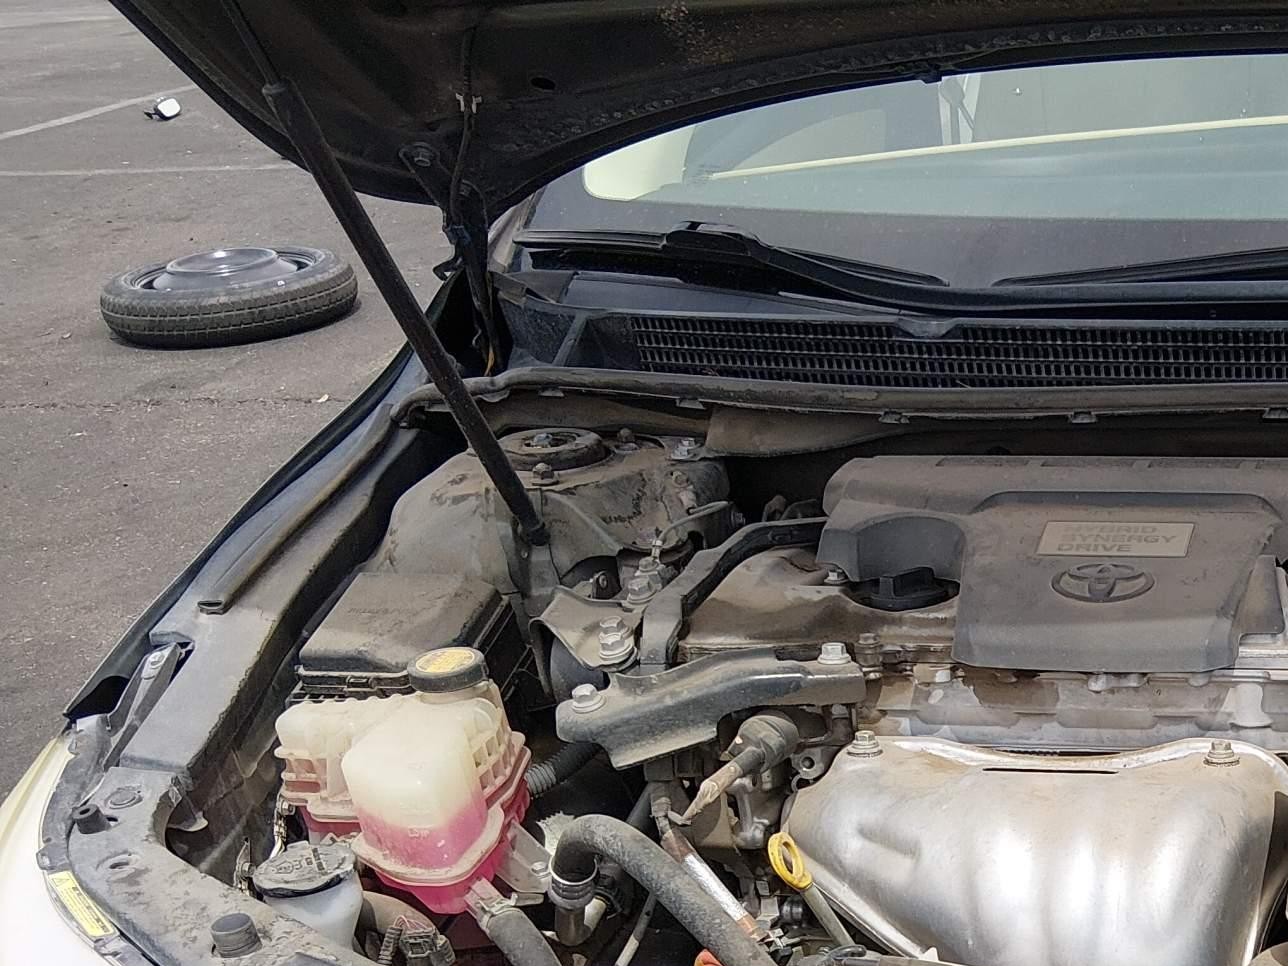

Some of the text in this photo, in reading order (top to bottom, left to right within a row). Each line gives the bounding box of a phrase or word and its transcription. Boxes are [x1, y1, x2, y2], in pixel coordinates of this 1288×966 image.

[1062, 525, 1158, 534] HYBRID
[1061, 534, 1178, 544] SYNERGY
[1057, 543, 1133, 553] DRIVE
